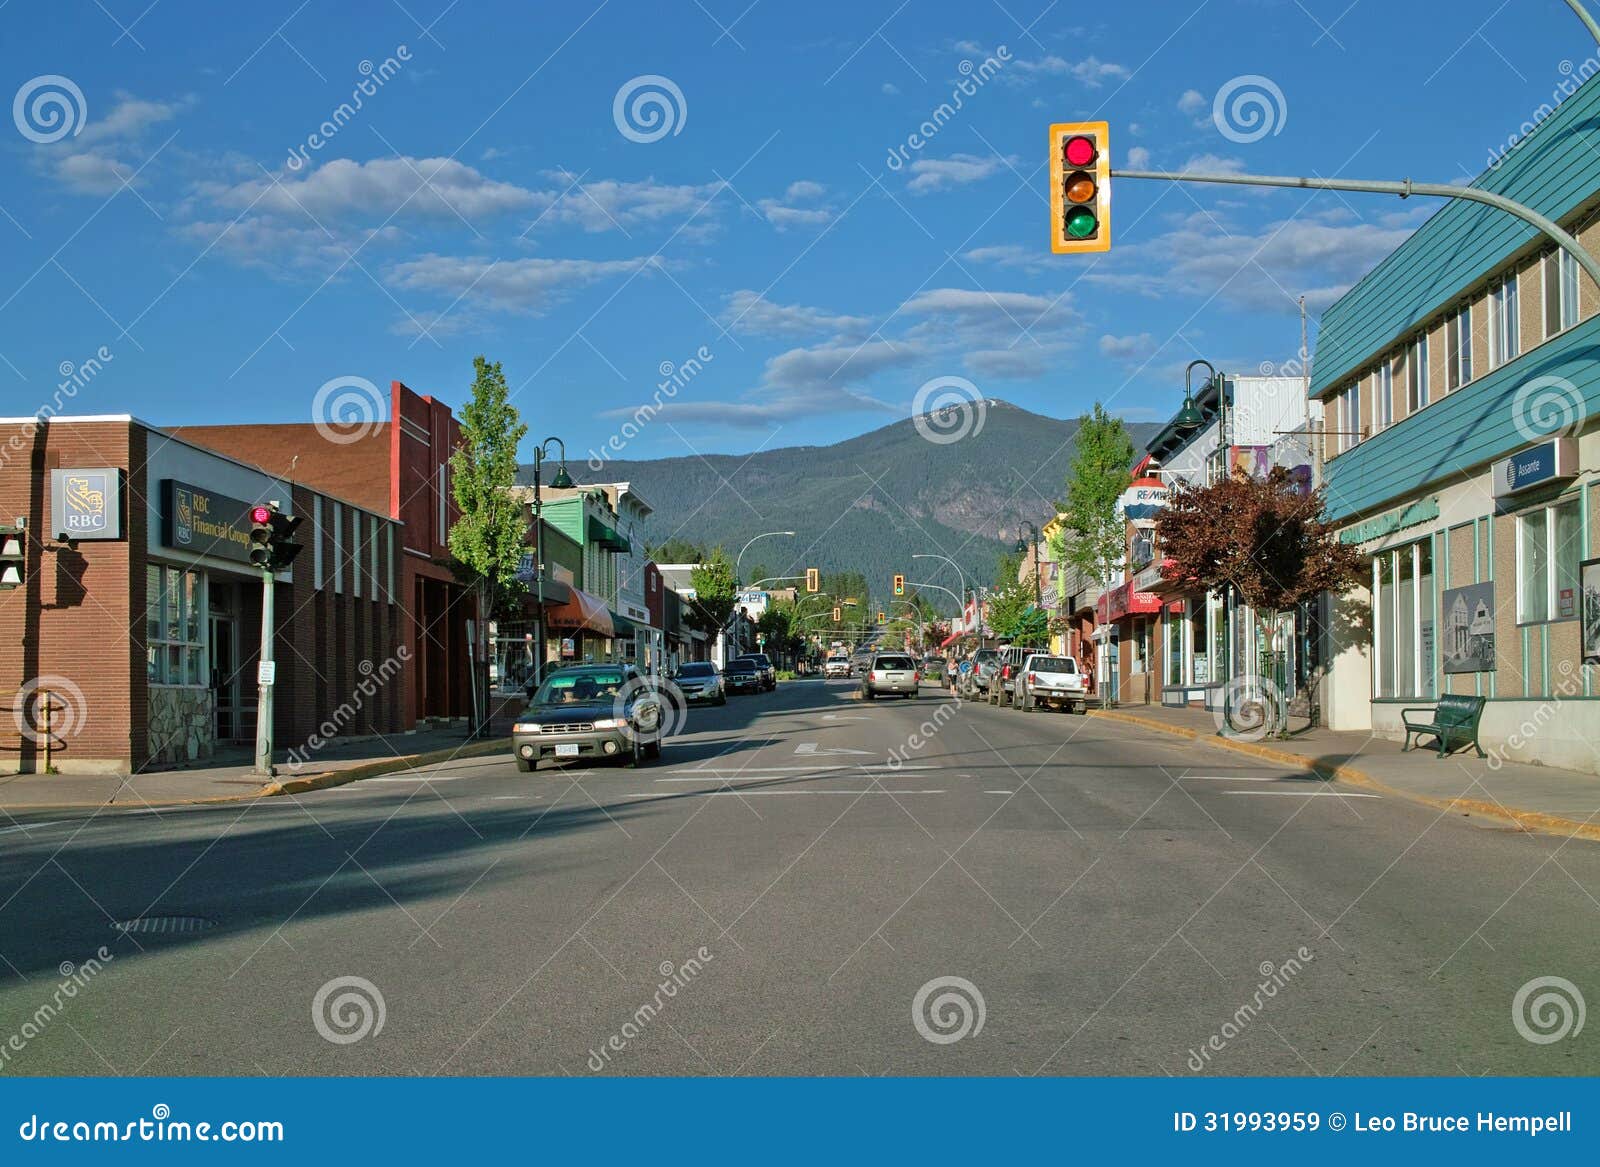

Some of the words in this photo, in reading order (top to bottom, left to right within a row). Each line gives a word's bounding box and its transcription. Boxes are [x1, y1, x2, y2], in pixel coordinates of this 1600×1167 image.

[1518, 459, 1541, 477] Assante
[193, 493, 210, 514] RBC
[69, 514, 104, 527] RBC
[193, 515, 228, 539] Financial
[229, 525, 250, 550] Group
